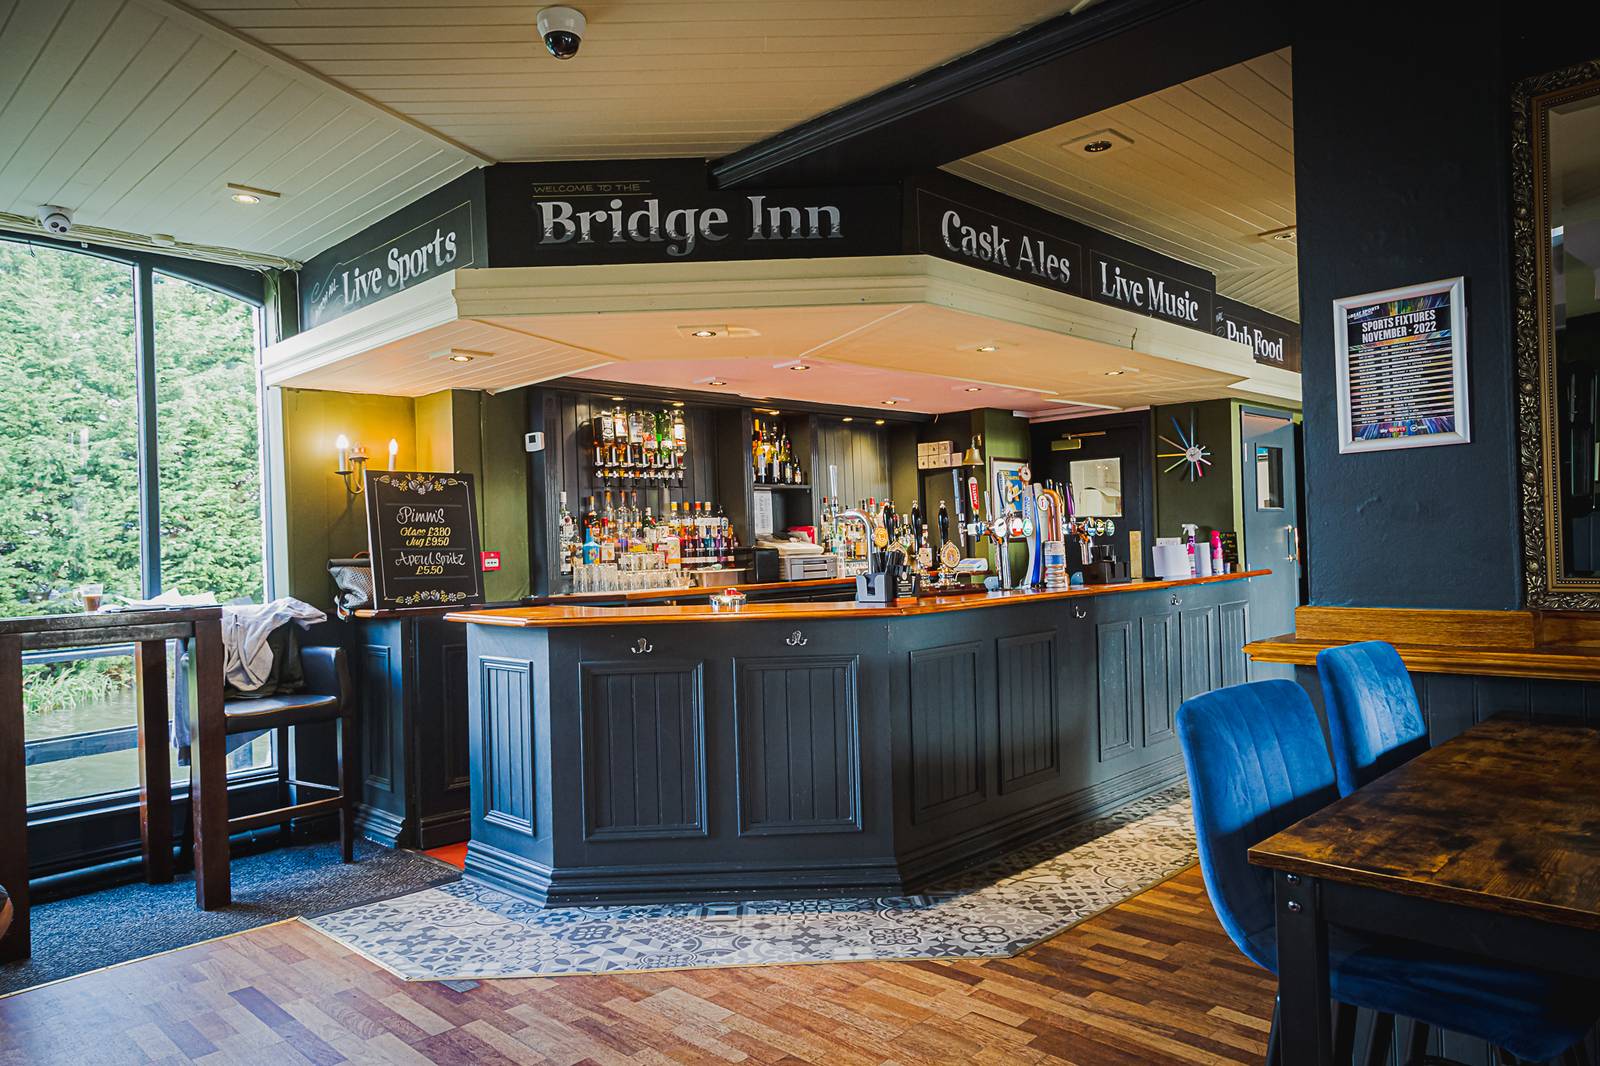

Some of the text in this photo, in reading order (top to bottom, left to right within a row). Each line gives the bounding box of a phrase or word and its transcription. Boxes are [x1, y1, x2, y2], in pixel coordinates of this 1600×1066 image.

[533, 183, 641, 193] WELCOME TO THE
[536, 195, 844, 257] Bridge Inn
[941, 209, 1071, 285] Cask Ales
[342, 267, 382, 307] Live
[387, 228, 457, 291] Sports
[1099, 261, 1199, 323] Live Music
[1362, 309, 1436, 333] SPORTS FIXTURES
[1362, 326, 1407, 343] NOVEMBER
[1413, 321, 1437, 335] 2022
[1226, 320, 1284, 362] Pub Food
[396, 506, 445, 525] Pimm's
[400, 527, 427, 537] Glass
[406, 537, 425, 548] Jug
[395, 551, 466, 567] Aperol Spritz
